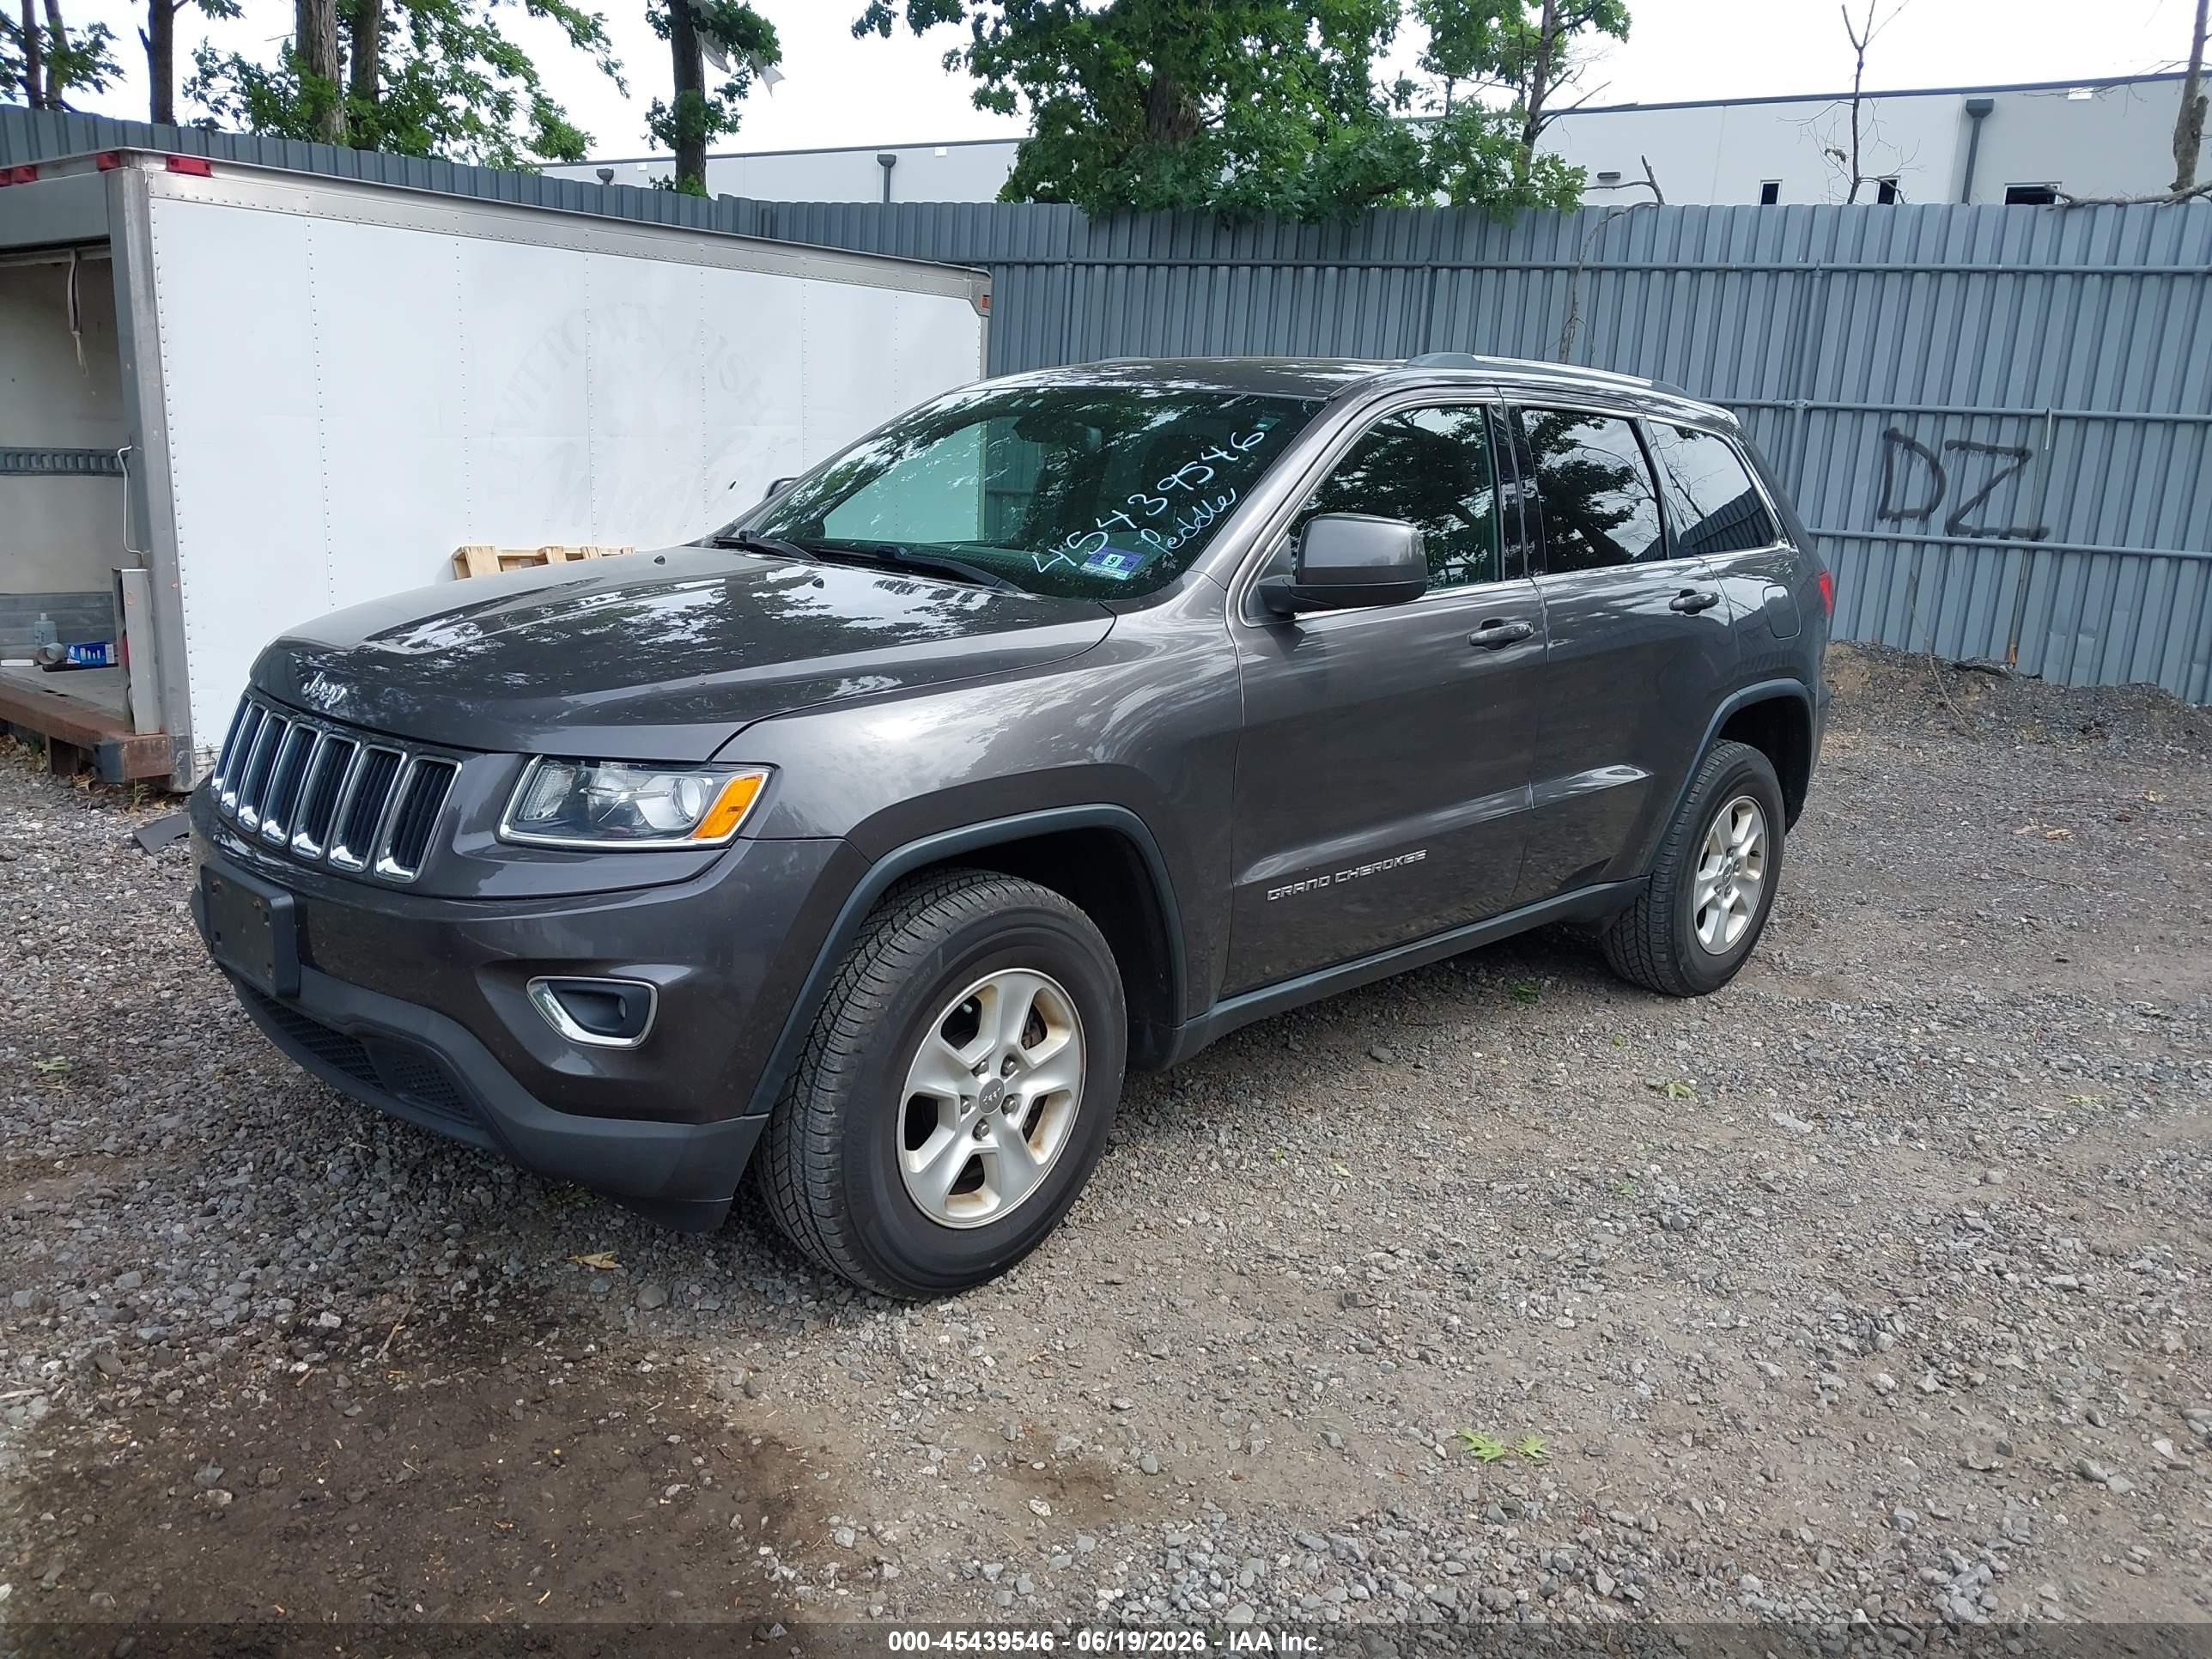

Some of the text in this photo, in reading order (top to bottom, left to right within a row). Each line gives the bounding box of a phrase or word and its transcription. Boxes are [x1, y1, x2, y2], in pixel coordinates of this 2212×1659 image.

[1031, 431, 1265, 574] 45439546
[1877, 427, 2051, 541] DZ
[1107, 556, 1119, 566] 9
[301, 671, 349, 710] Jeep
[1267, 849, 1428, 901] GRAND CHEROKEE
